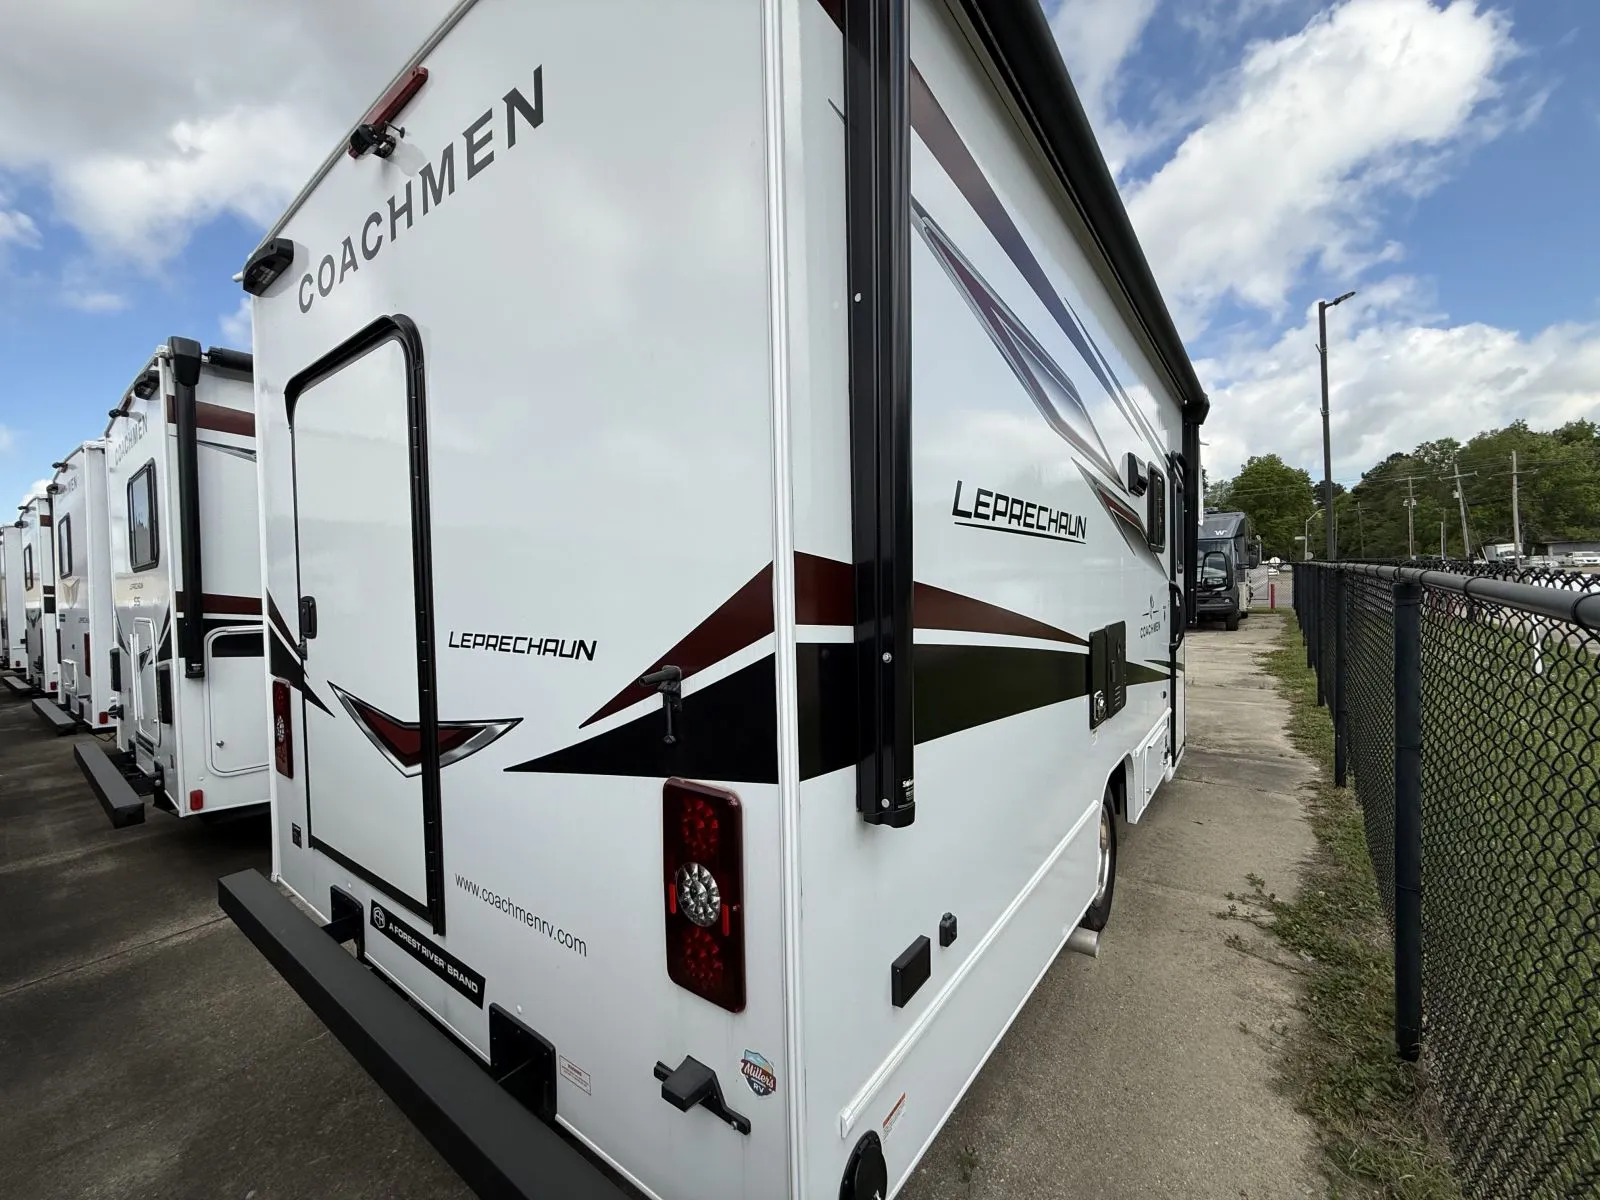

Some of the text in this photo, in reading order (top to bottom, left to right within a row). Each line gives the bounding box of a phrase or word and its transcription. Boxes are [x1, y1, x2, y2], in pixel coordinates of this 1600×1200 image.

[298, 63, 545, 314] COACHMEN
[952, 480, 1087, 540] LEPRECHAUN
[448, 631, 598, 662] LEPRECHAUN
[454, 872, 588, 958] www.coachmenrv.com
[394, 926, 421, 951] FOREST
[447, 963, 479, 994] BRAND
[753, 1082, 765, 1093] RV
